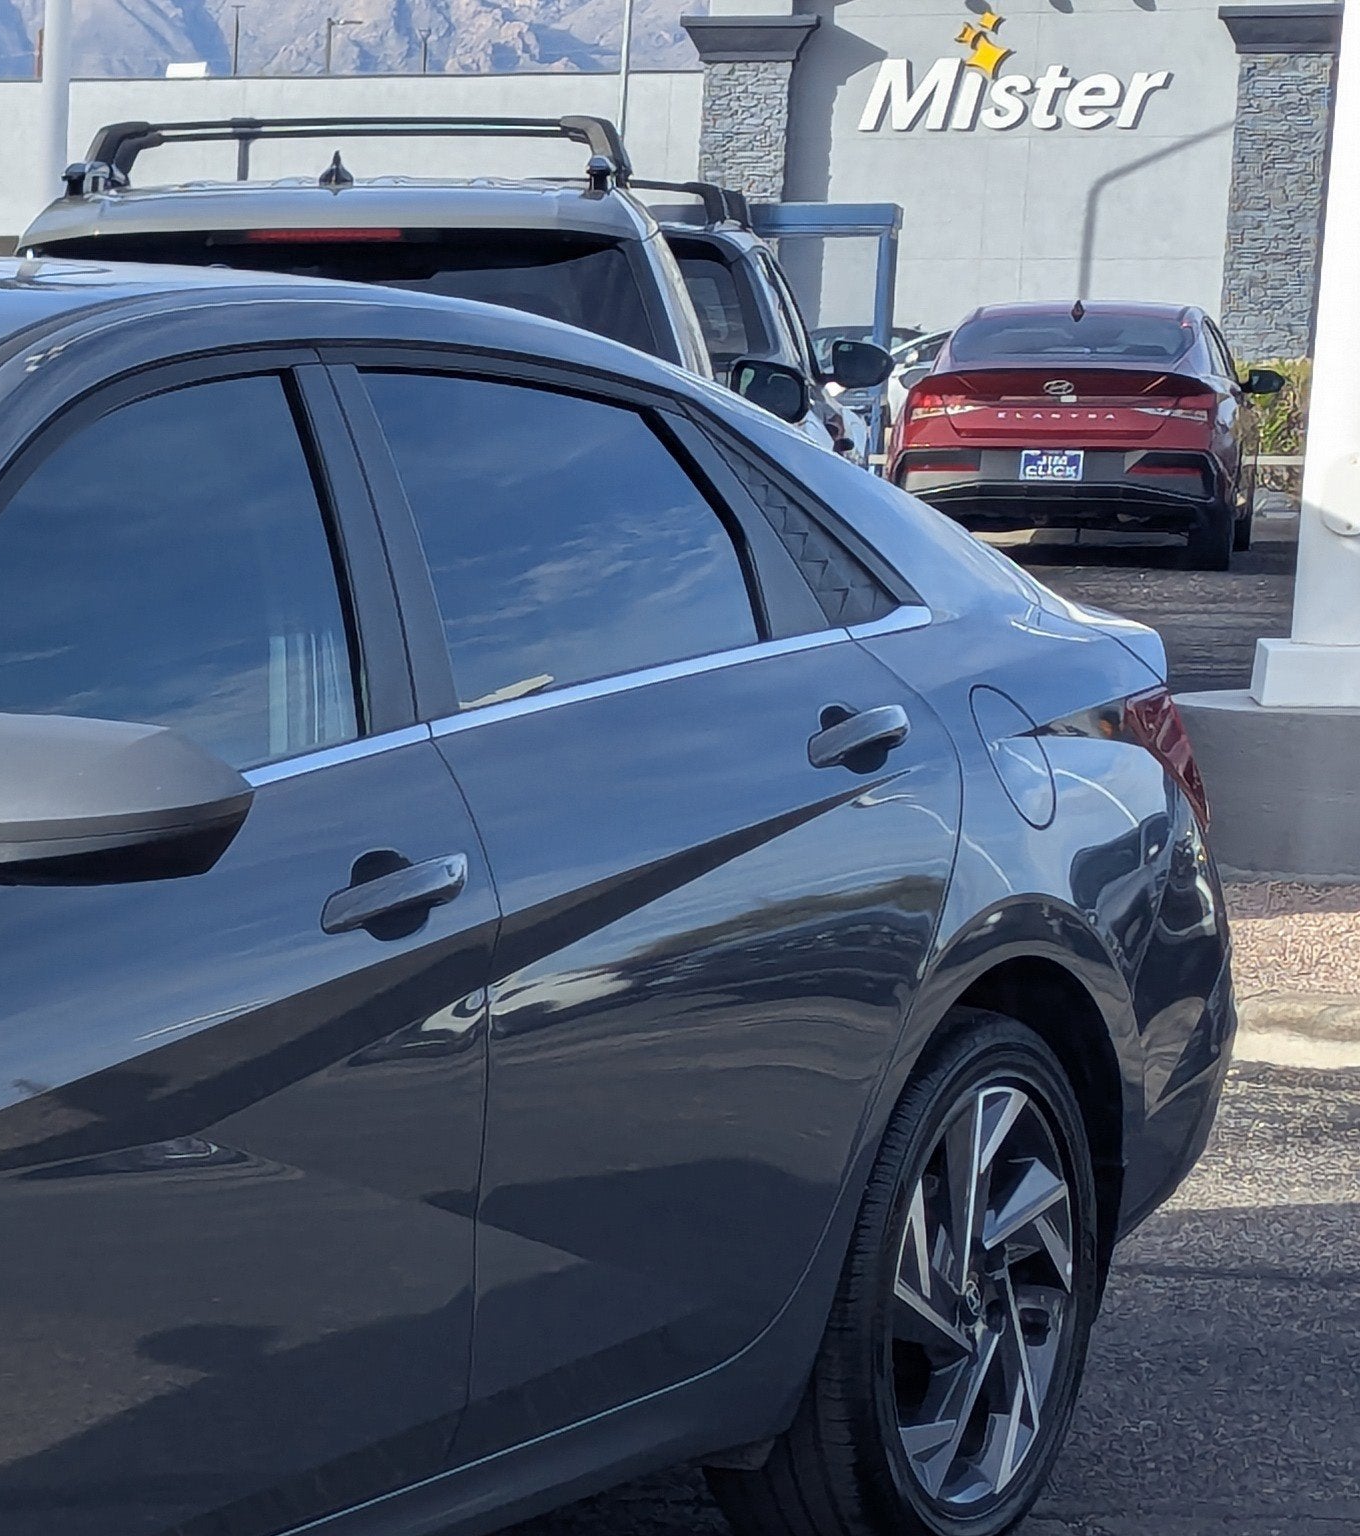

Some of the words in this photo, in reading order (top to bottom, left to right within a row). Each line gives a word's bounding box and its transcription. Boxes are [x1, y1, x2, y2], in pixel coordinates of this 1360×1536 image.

[857, 57, 1174, 131] Mister
[1037, 455, 1068, 465] JIM
[1025, 465, 1078, 477] CLICK
